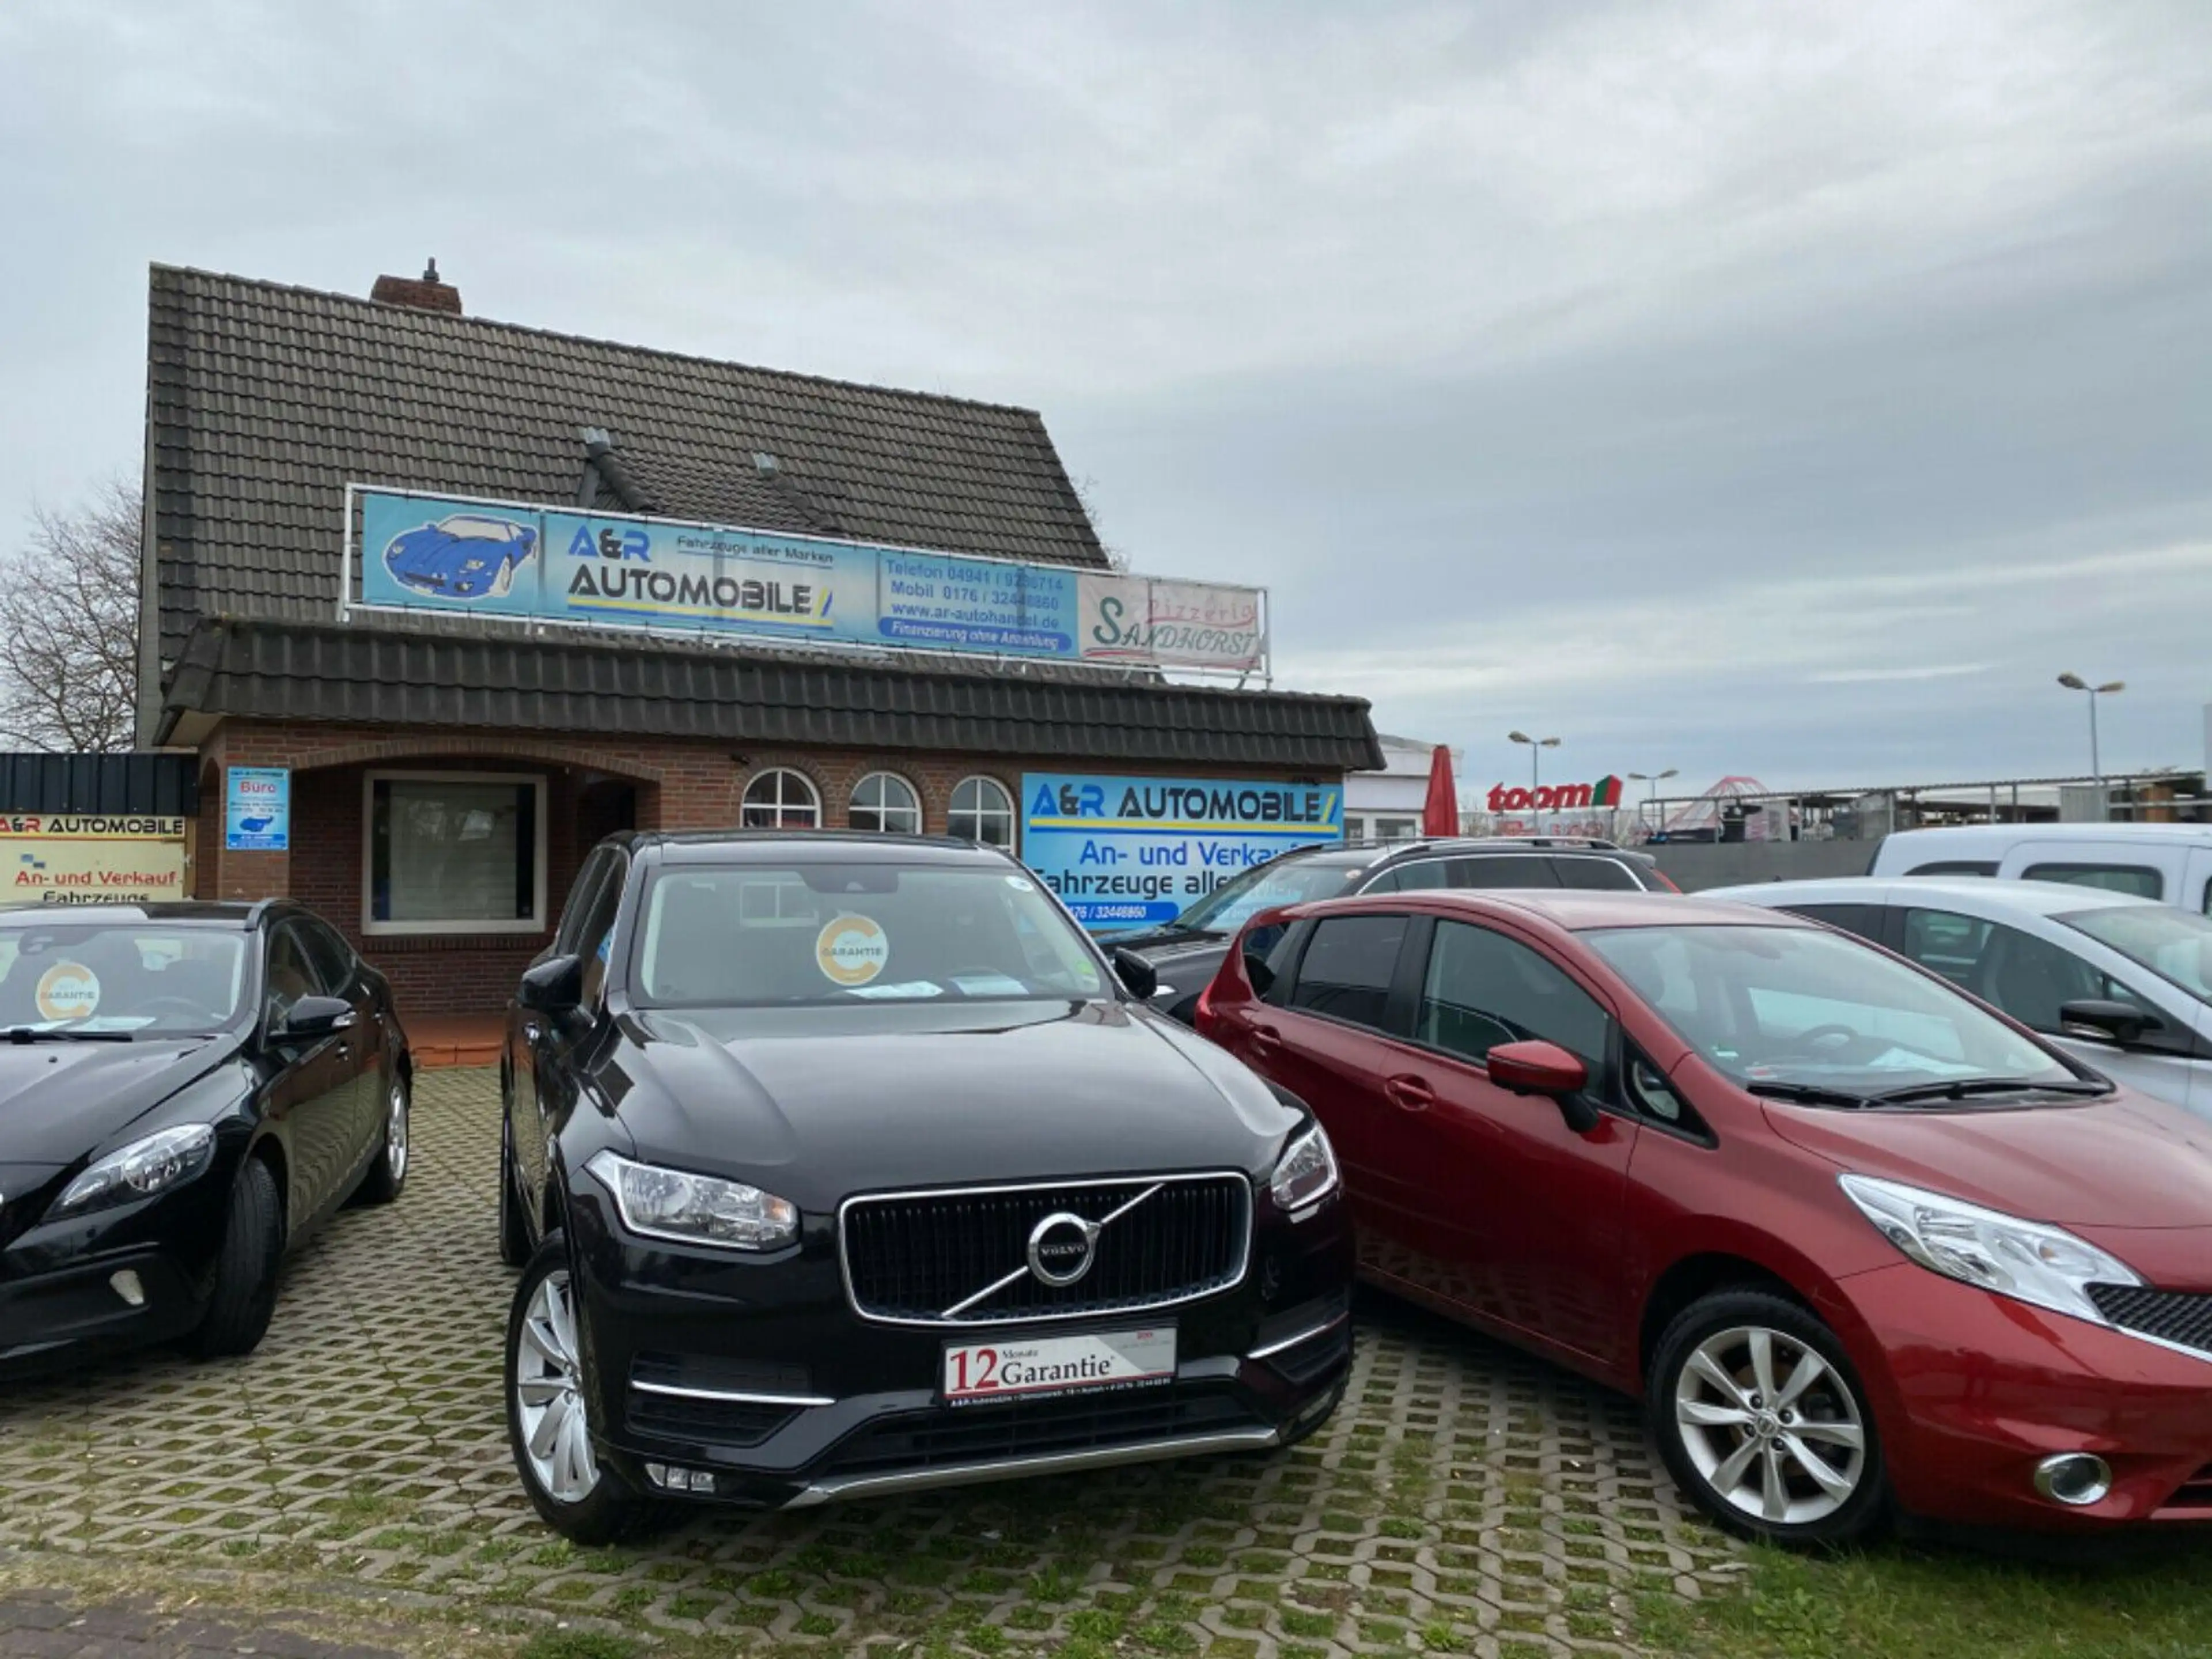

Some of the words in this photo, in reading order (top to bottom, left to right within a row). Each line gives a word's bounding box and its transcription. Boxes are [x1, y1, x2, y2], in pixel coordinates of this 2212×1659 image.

[568, 525, 651, 563] A&R
[676, 536, 747, 555] Fahrzeuge
[752, 543, 781, 556] aller
[785, 547, 834, 564] Marken
[887, 559, 943, 579] Telefon
[568, 564, 812, 615] AUTOMOBILE
[891, 580, 934, 598] Mobil
[942, 585, 978, 603] 0176
[1032, 783, 1105, 817] A&R
[1117, 787, 1321, 822] AUTOMOBILE
[1487, 782, 1592, 812] toom
[48, 819, 183, 834] AUTOMOBILE
[1080, 840, 1127, 865] An-
[1139, 841, 1188, 865] und
[1198, 842, 1298, 866] Verka
[16, 870, 50, 884] An-
[55, 870, 92, 885] und
[98, 870, 177, 885] Verkauf
[1033, 868, 1173, 900] ahrzeuge
[1184, 870, 1237, 895] alle
[821, 947, 884, 957] GARANTIE
[1041, 1245, 1085, 1255] VOLVO
[949, 1348, 999, 1392] 12
[1000, 1354, 1112, 1386] Garantie
